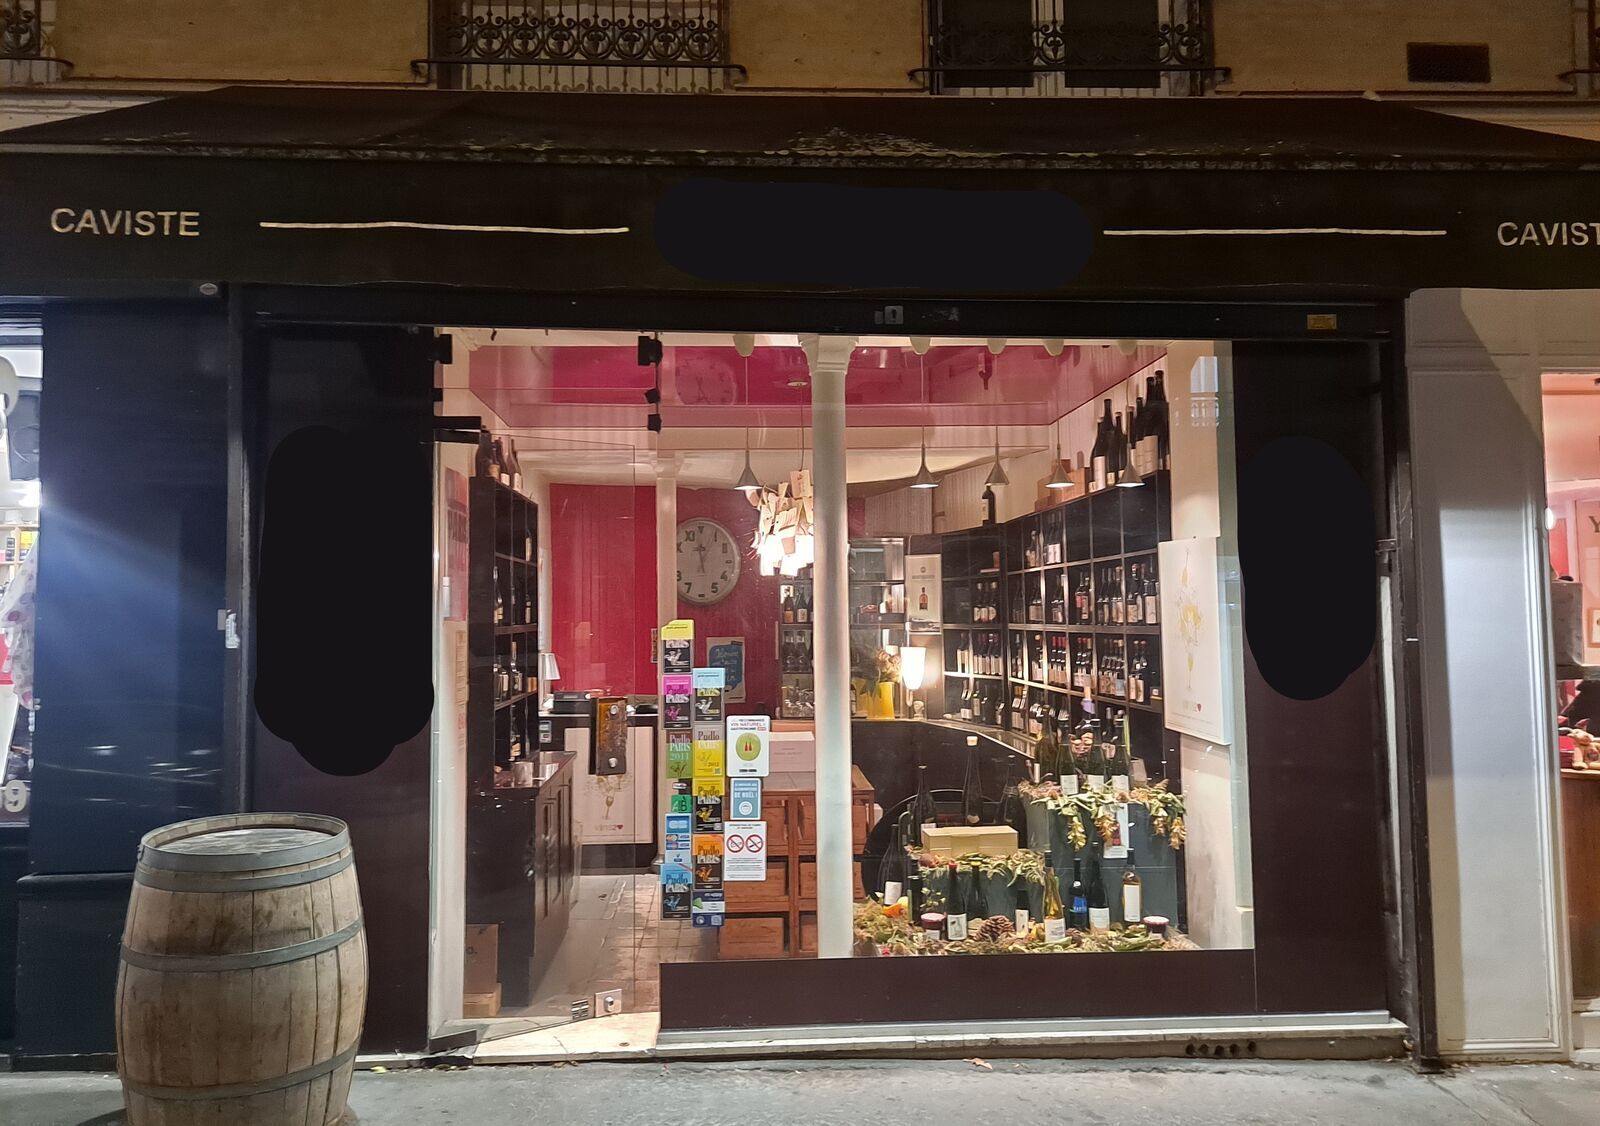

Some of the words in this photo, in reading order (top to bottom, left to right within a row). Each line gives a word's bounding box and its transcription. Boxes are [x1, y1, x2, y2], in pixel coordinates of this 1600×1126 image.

[50, 207, 200, 236] CAVISTE
[684, 582, 692, 593] 7
[711, 582, 720, 593] 5
[670, 734, 691, 743] Pudlo
[698, 731, 720, 740] Pudlo
[669, 743, 691, 751] PARIS
